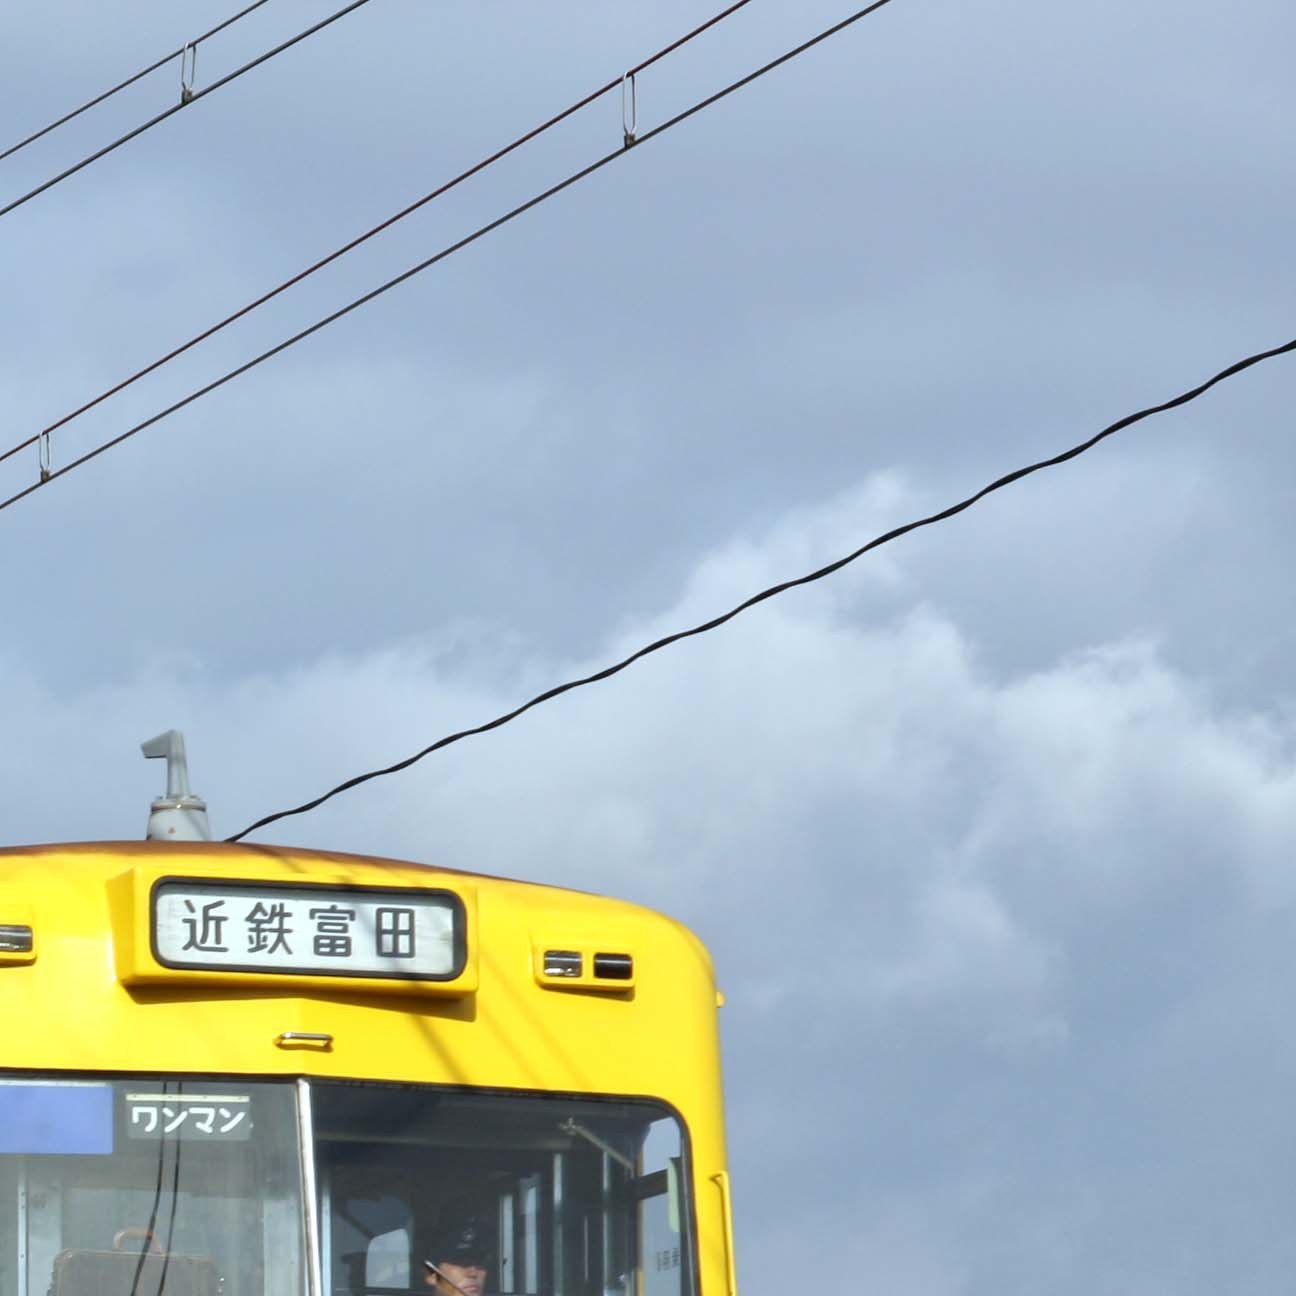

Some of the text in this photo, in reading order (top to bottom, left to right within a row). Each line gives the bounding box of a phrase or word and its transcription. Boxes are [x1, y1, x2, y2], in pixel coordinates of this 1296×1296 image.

[182, 899, 416, 958] 近鉄富田
[132, 1106, 246, 1133] ワンマン
